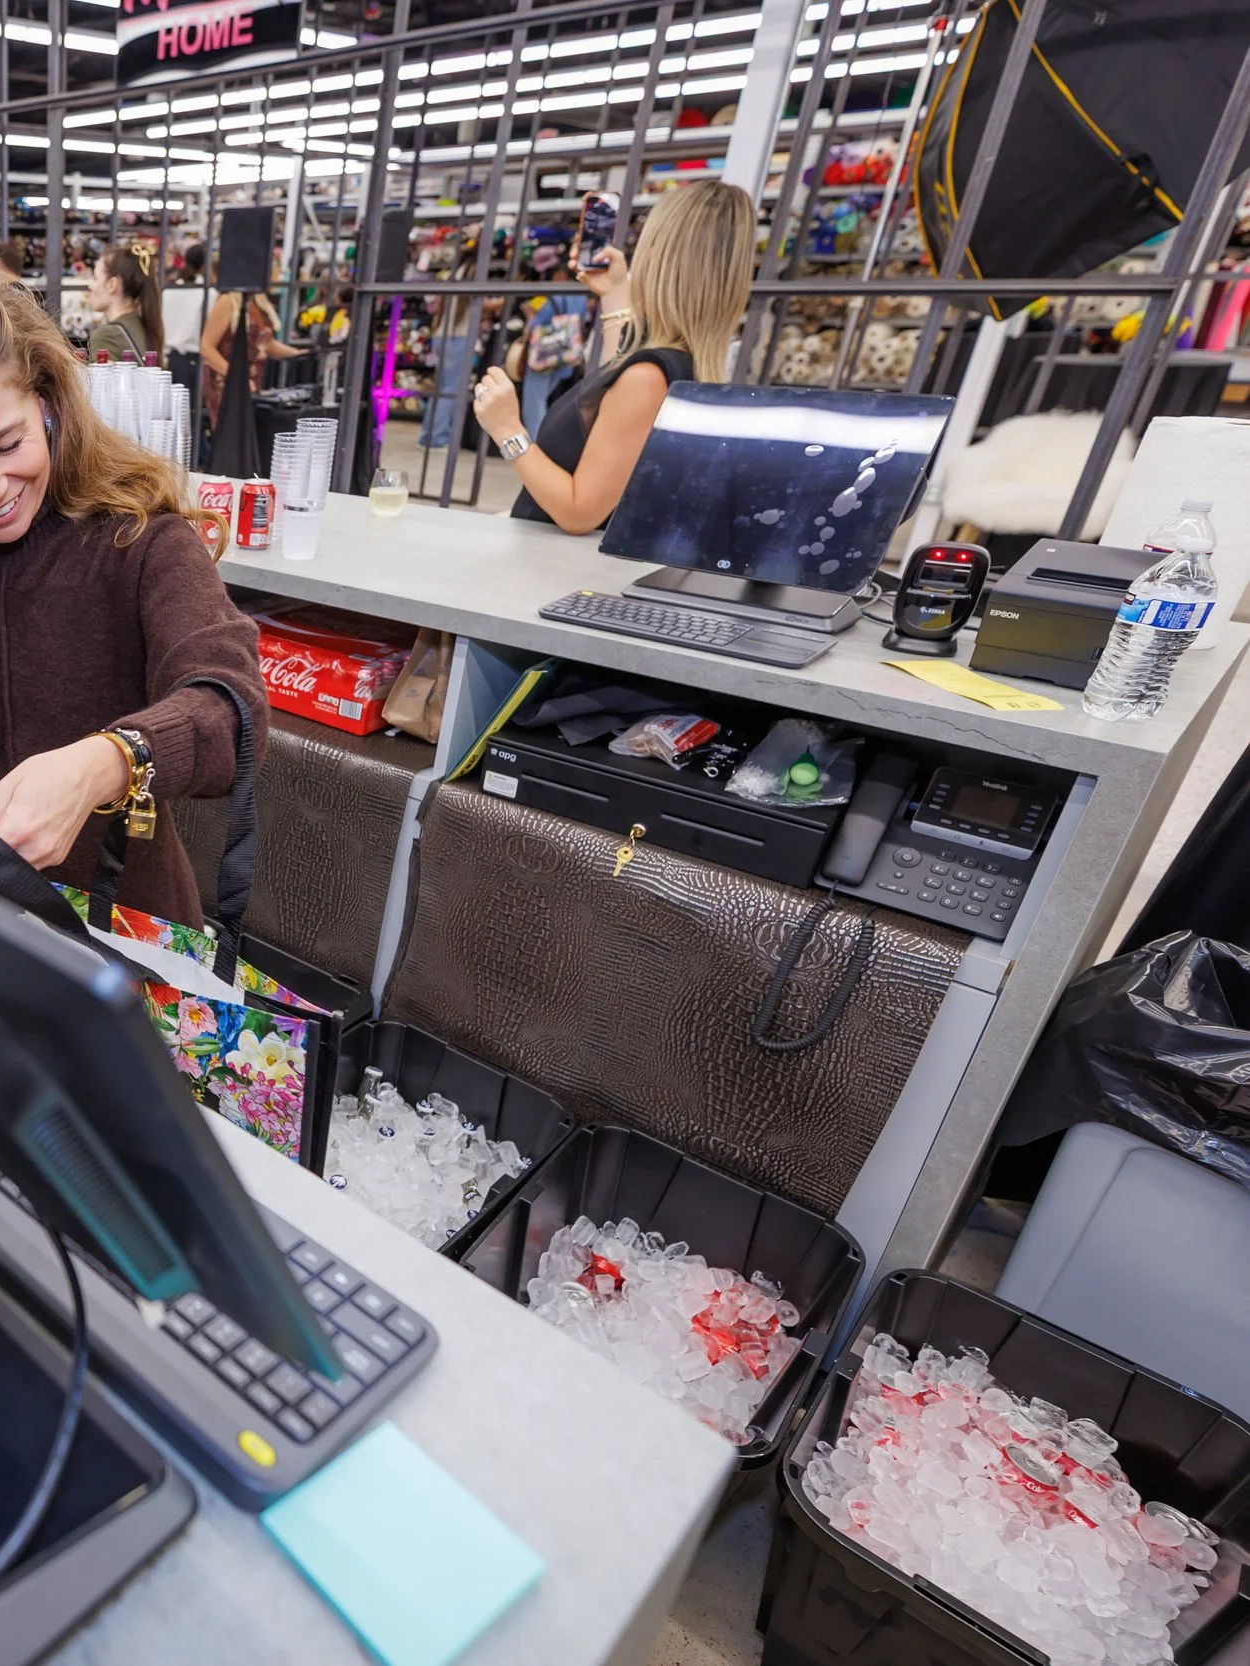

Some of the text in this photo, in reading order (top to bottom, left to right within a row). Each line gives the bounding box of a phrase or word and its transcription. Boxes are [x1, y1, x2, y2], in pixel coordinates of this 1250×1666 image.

[157, 8, 254, 60] HOME
[989, 608, 1020, 620] EPSON
[278, 688, 299, 699] TASTE
[498, 751, 517, 763] apg
